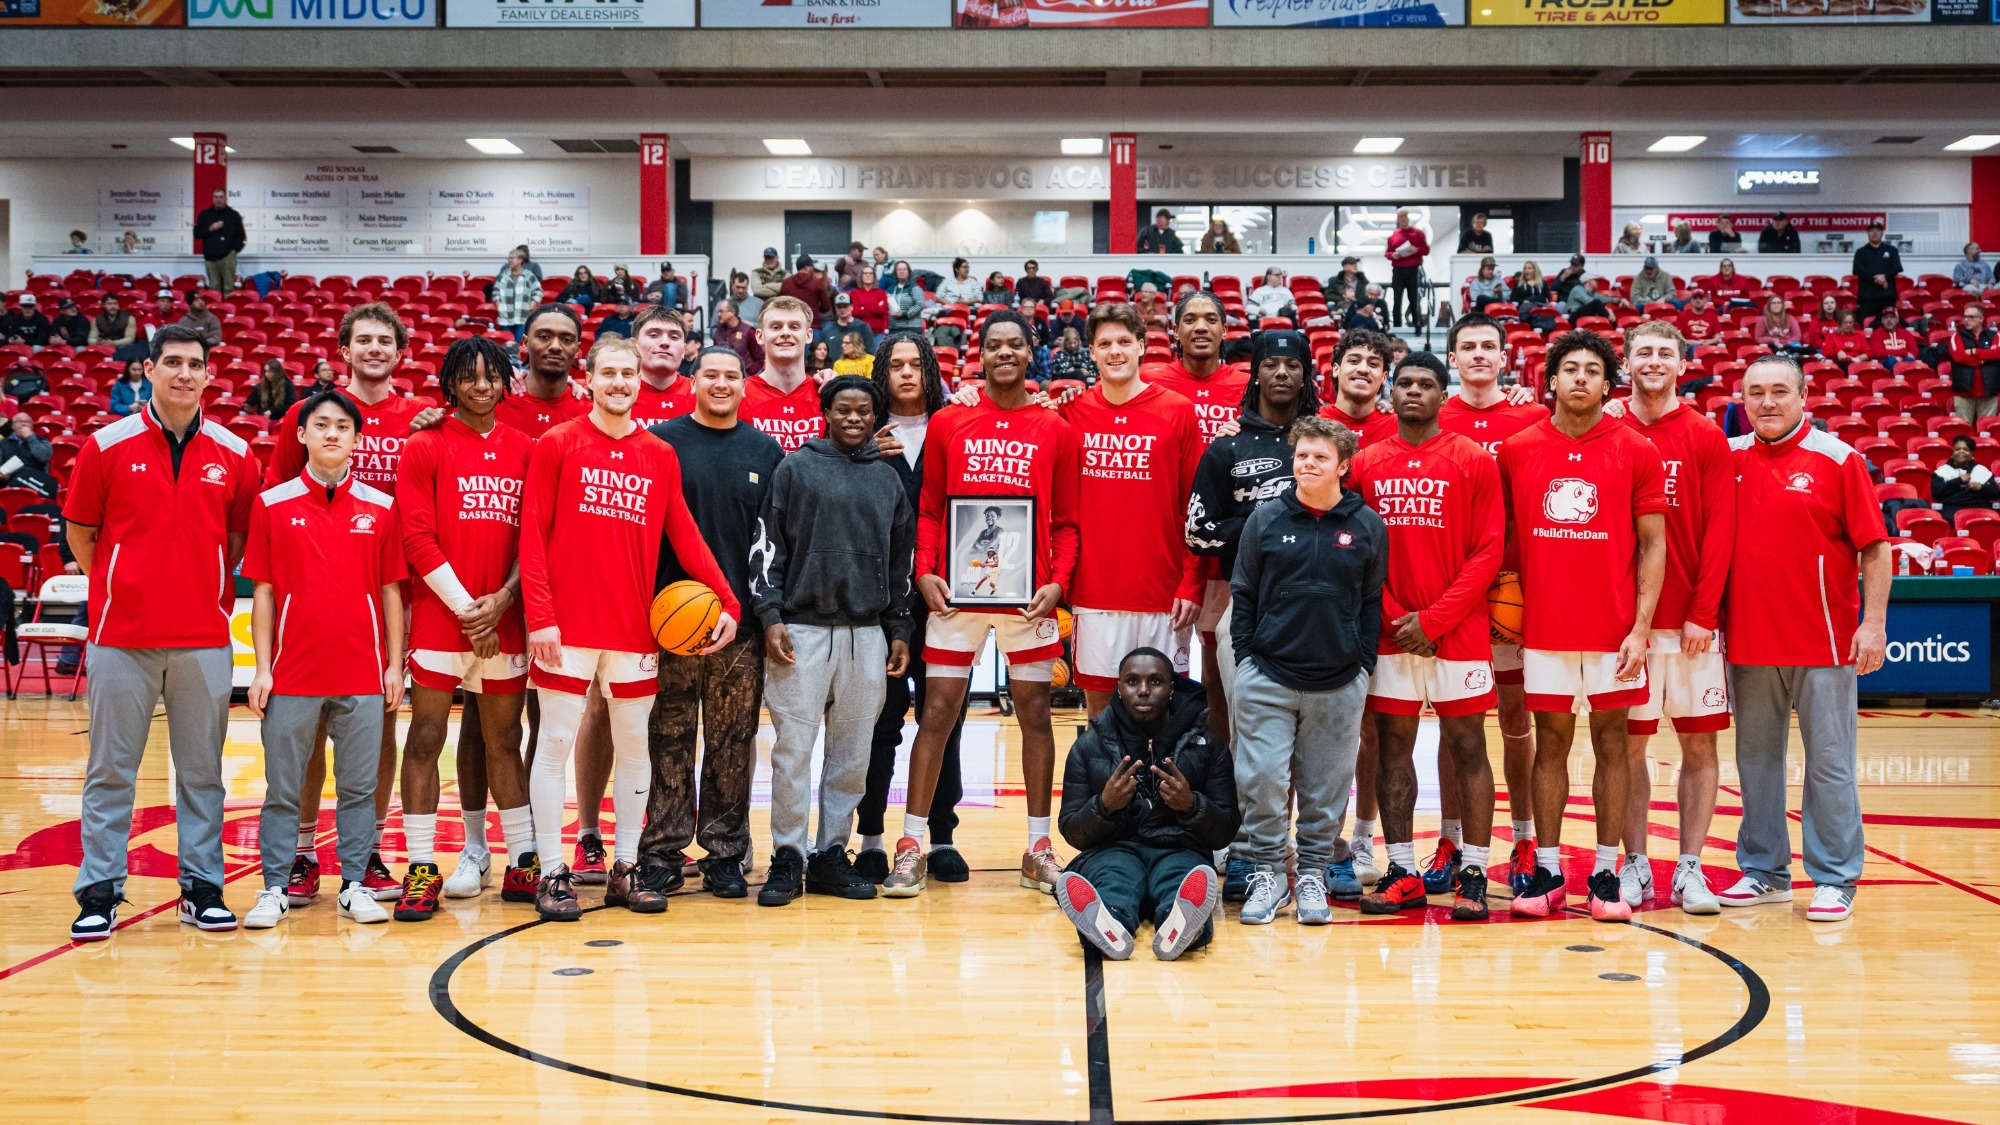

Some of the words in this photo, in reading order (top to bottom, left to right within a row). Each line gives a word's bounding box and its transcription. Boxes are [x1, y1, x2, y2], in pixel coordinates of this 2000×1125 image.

[501, 10, 547, 20] FAMILY
[551, 10, 640, 20] DEALERSHIPS
[807, 11, 828, 23] live
[831, 13, 855, 26] first
[1534, 11, 1578, 22] TIRE
[1584, 11, 1596, 22] &
[1601, 11, 1660, 22] AUTO
[196, 144, 216, 164] 12
[643, 145, 664, 164] 12
[1116, 144, 1130, 164] 11
[1589, 143, 1609, 163] 10
[764, 166, 845, 189] DEAN
[857, 165, 1033, 189] FRANTSVOG
[1046, 164, 1201, 188] ACAEMIC
[1213, 163, 1355, 188] SUCCESS
[1367, 163, 1487, 188] CENTER
[1745, 170, 1820, 184] PINNACLE
[1684, 218, 1718, 227] STUDE
[1735, 218, 1774, 227] ATHLET
[1790, 218, 1804, 226] OF
[1808, 218, 1829, 226] THE
[1832, 218, 1871, 226] MONTH
[446, 238, 471, 246] Jordan
[1193, 404, 1238, 420] NOT
[752, 416, 823, 434] MINOT
[356, 435, 407, 452] INOT
[963, 438, 1038, 460] MINOT
[1083, 432, 1156, 450] MINOT
[349, 452, 400, 471] STAT
[967, 456, 1031, 476] STATE
[1085, 450, 1150, 469] STATE
[1235, 461, 1274, 475] STAR
[580, 466, 653, 496] MINOT
[963, 473, 1032, 489] BASKETBALL
[1082, 467, 1152, 480] BASKETBALL
[456, 475, 523, 496] MINOT
[1374, 478, 1450, 497] MINOT
[462, 493, 520, 515] STATE
[583, 485, 647, 514] STATE
[1378, 497, 1443, 516] STATE
[458, 510, 520, 527] BASKETBALL
[578, 503, 647, 526] BASKETBALL
[1382, 516, 1445, 529] ASKETBALL
[1533, 528, 1609, 540] #BuildTheDam
[1885, 634, 1970, 663] ontics
